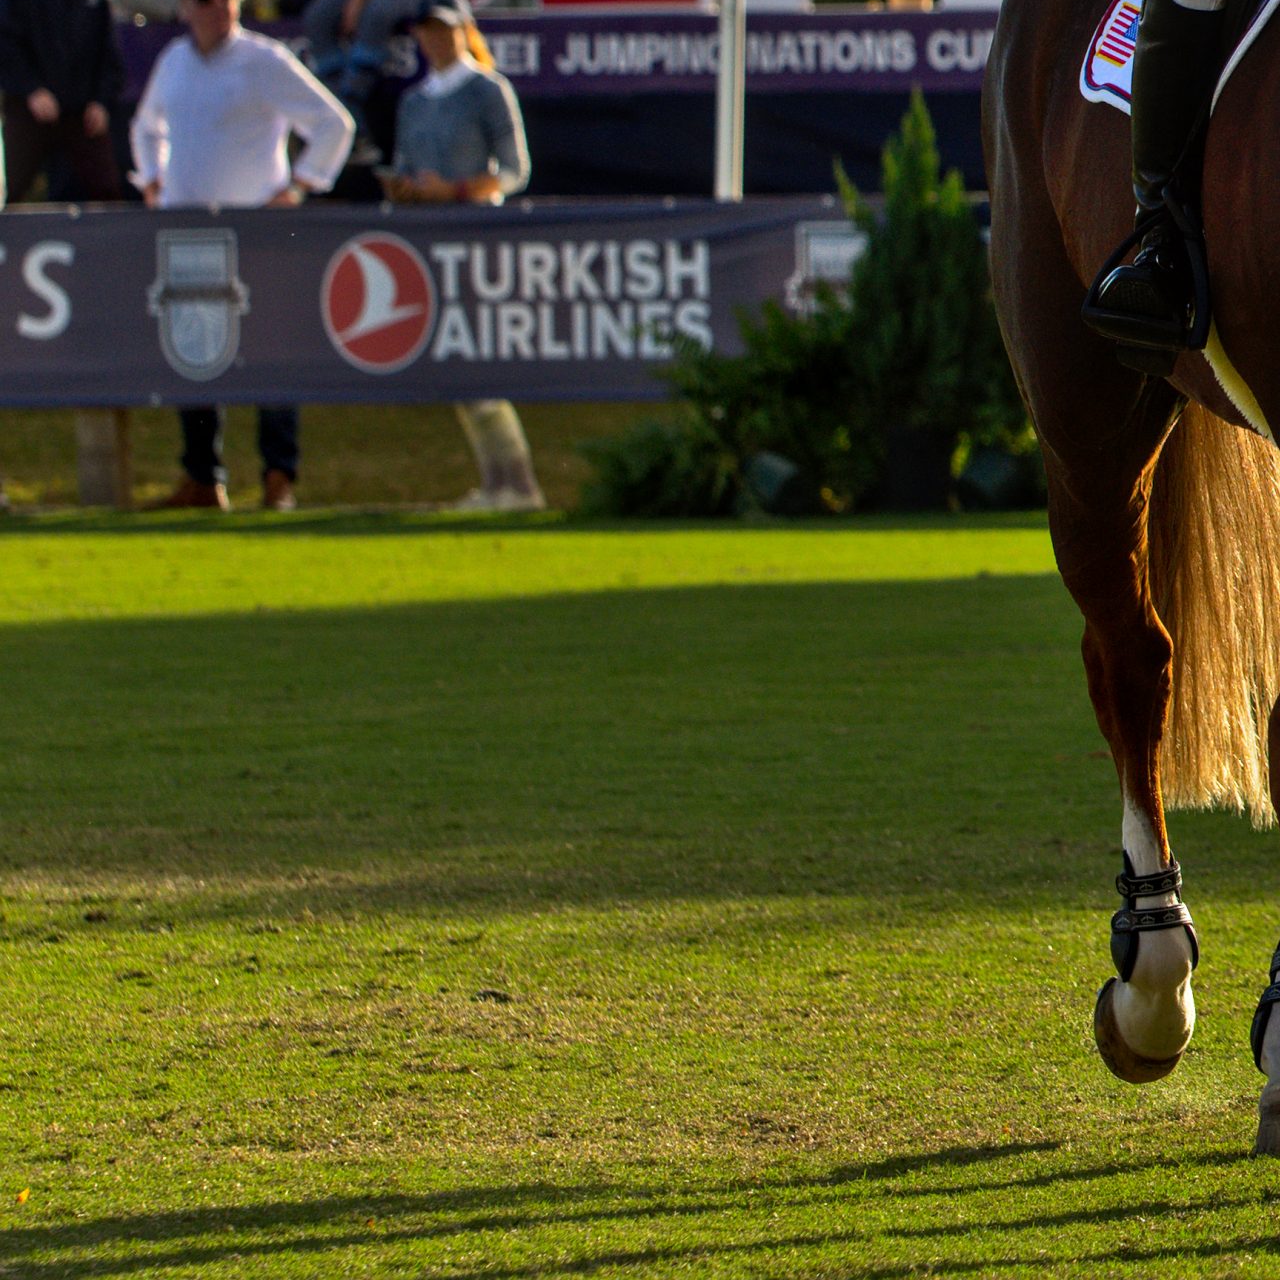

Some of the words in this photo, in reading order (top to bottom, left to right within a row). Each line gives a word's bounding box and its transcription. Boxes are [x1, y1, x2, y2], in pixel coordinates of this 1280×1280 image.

[747, 29, 916, 73] NATIONS
[430, 239, 711, 300] TURKISH
[432, 300, 714, 361] AIRLINES
